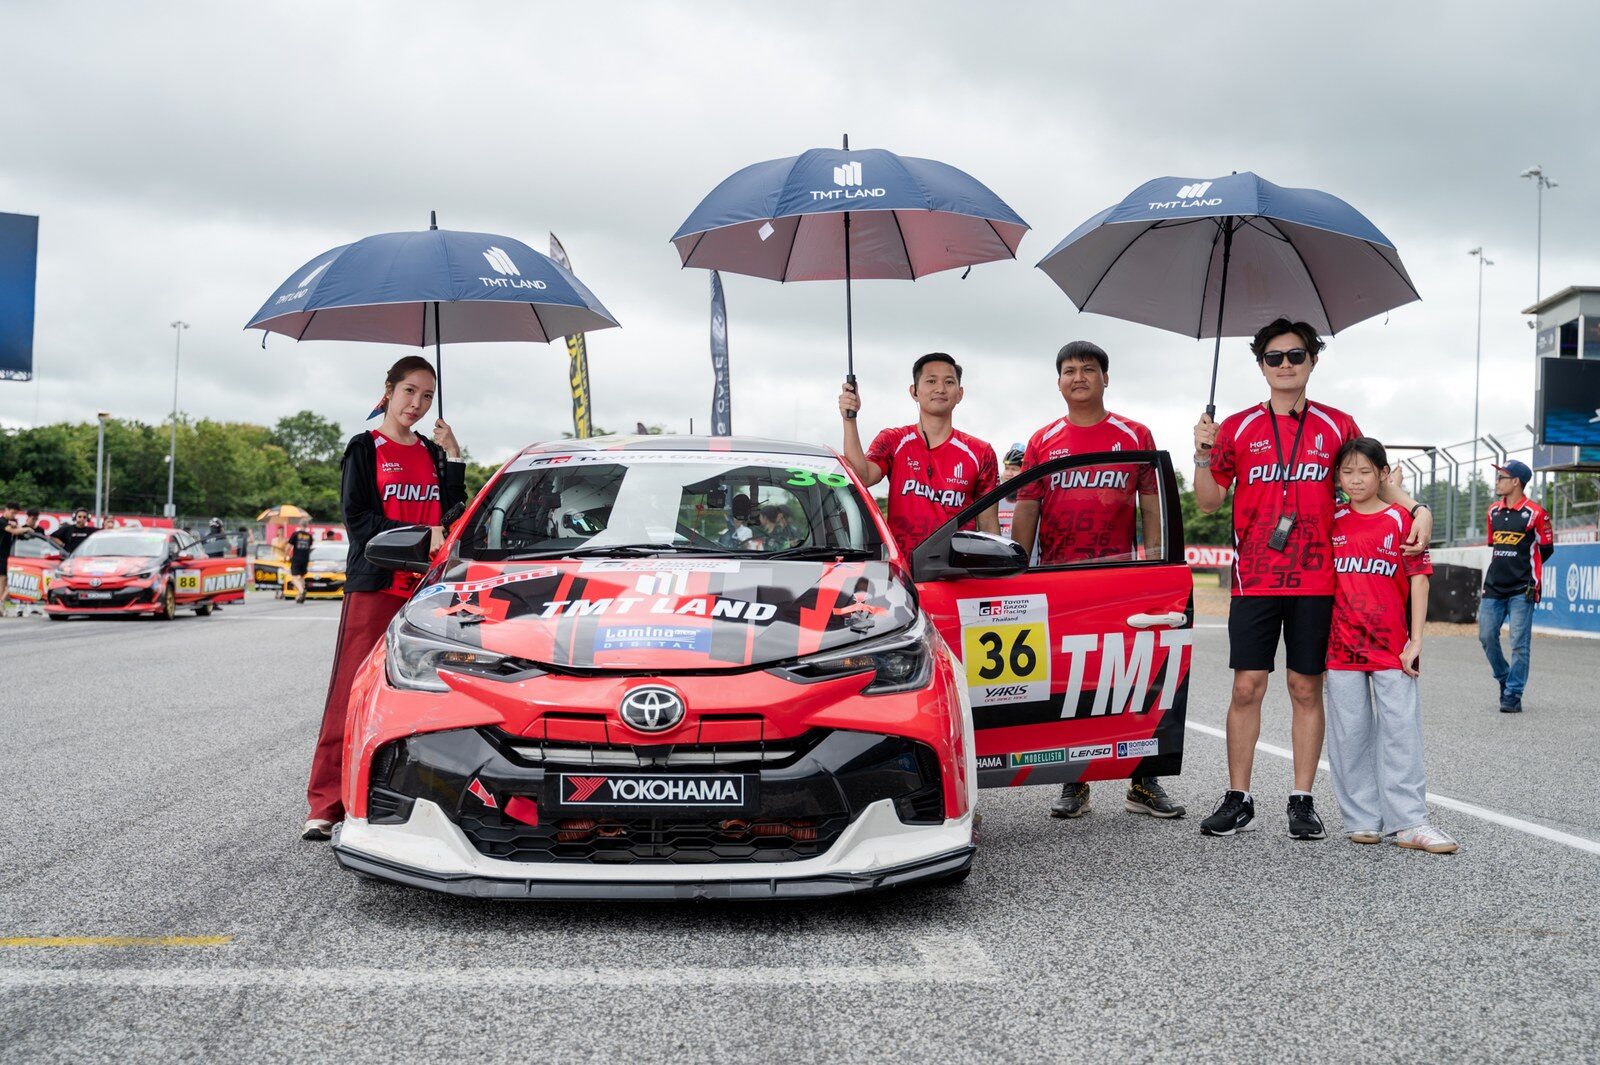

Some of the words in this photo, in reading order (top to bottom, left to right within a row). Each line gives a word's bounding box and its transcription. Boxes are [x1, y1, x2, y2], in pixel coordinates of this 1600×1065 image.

[810, 189, 843, 200] TMT
[845, 188, 886, 198] LAND
[1148, 201, 1180, 210] TMT
[1181, 198, 1222, 208] LAND
[479, 276, 508, 287] TMT
[510, 279, 547, 289] LAND
[1049, 448, 1069, 456] HGR
[785, 467, 850, 487] 36
[1051, 470, 1130, 490] PUNJAN
[383, 483, 440, 501] PUNJA
[1184, 547, 1234, 565] OND
[180, 577, 197, 588] 88
[1268, 571, 1301, 588] 36
[1579, 566, 1600, 600] YAM
[540, 597, 644, 618] TMT
[649, 597, 778, 621] LAND
[980, 603, 1002, 616] GR
[606, 626, 674, 638] Lamina
[604, 641, 696, 650] DIGITAL
[978, 629, 1037, 680] 36
[1341, 649, 1369, 664] 36
[1060, 628, 1193, 718] TMT
[985, 685, 1029, 697] YARIS
[1024, 752, 1062, 763] MODELLISTA
[1070, 747, 1111, 758] LENSO
[976, 756, 1002, 768] HAMA
[607, 778, 739, 801] YOKOHAMA
